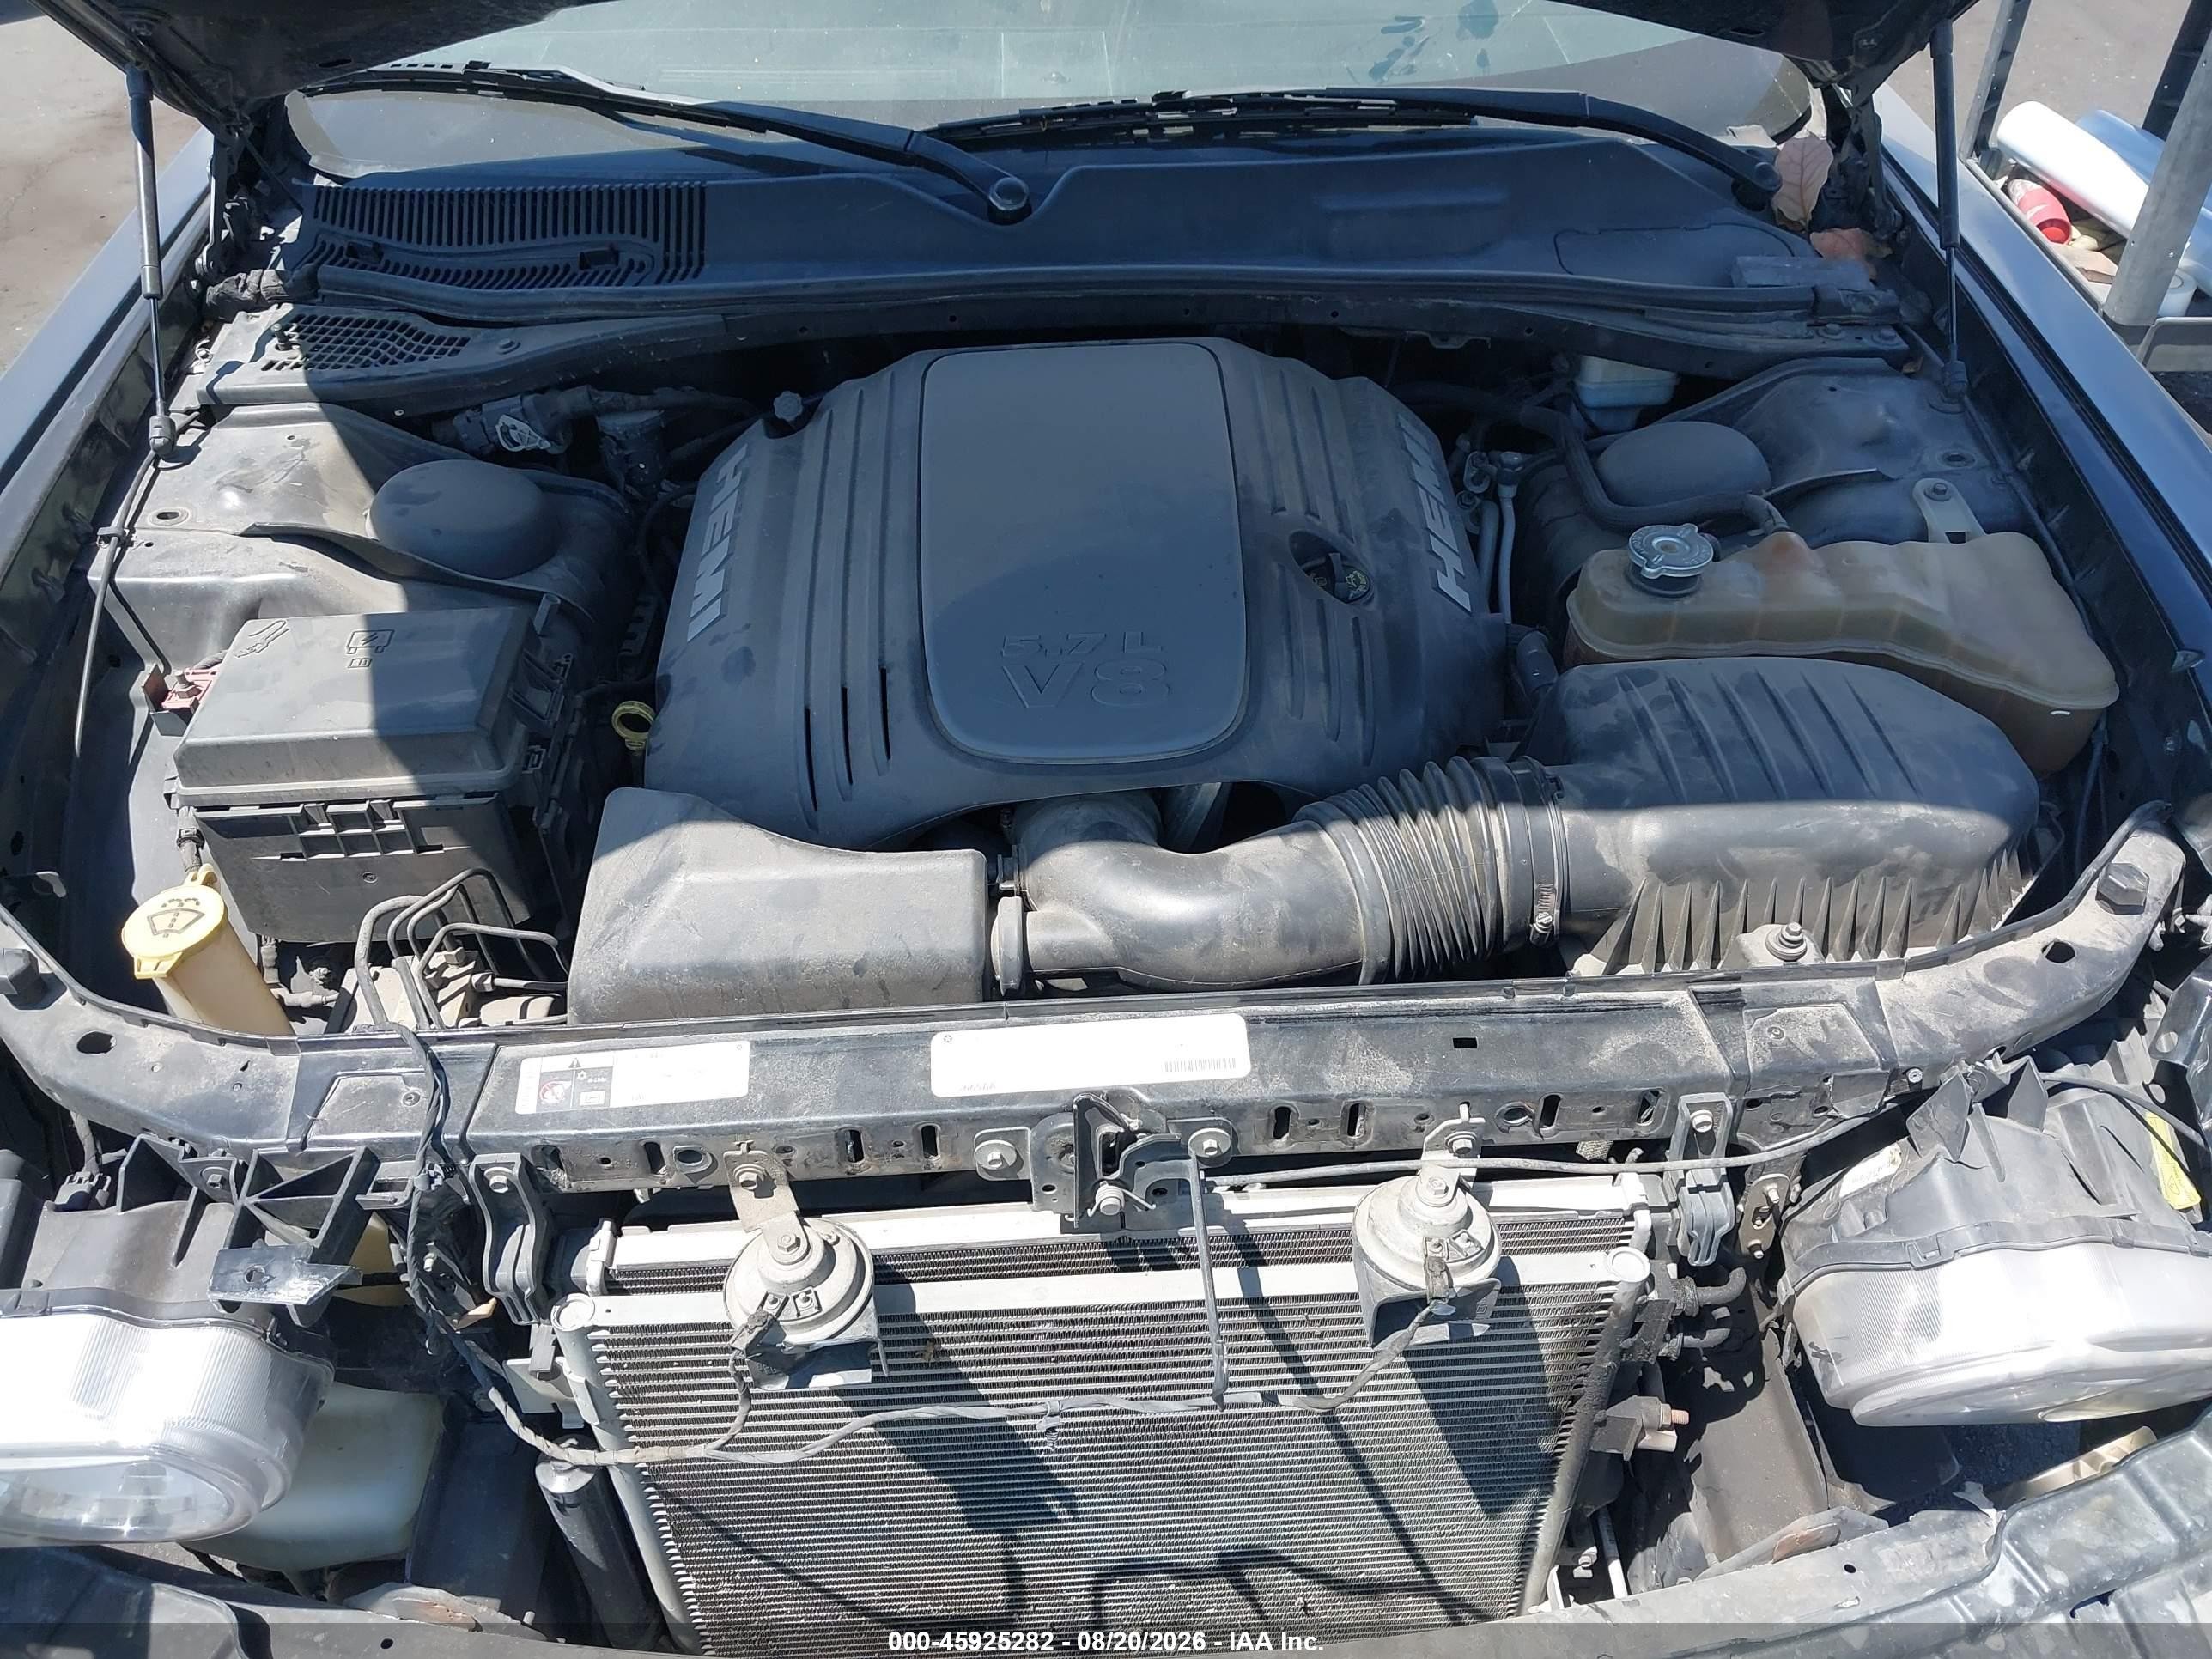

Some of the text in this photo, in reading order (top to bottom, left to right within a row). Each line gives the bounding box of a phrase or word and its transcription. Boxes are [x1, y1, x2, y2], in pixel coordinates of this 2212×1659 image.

[687, 443, 748, 643] HEMI
[1397, 413, 1471, 612] HEMI
[1002, 659, 1171, 708] V8
